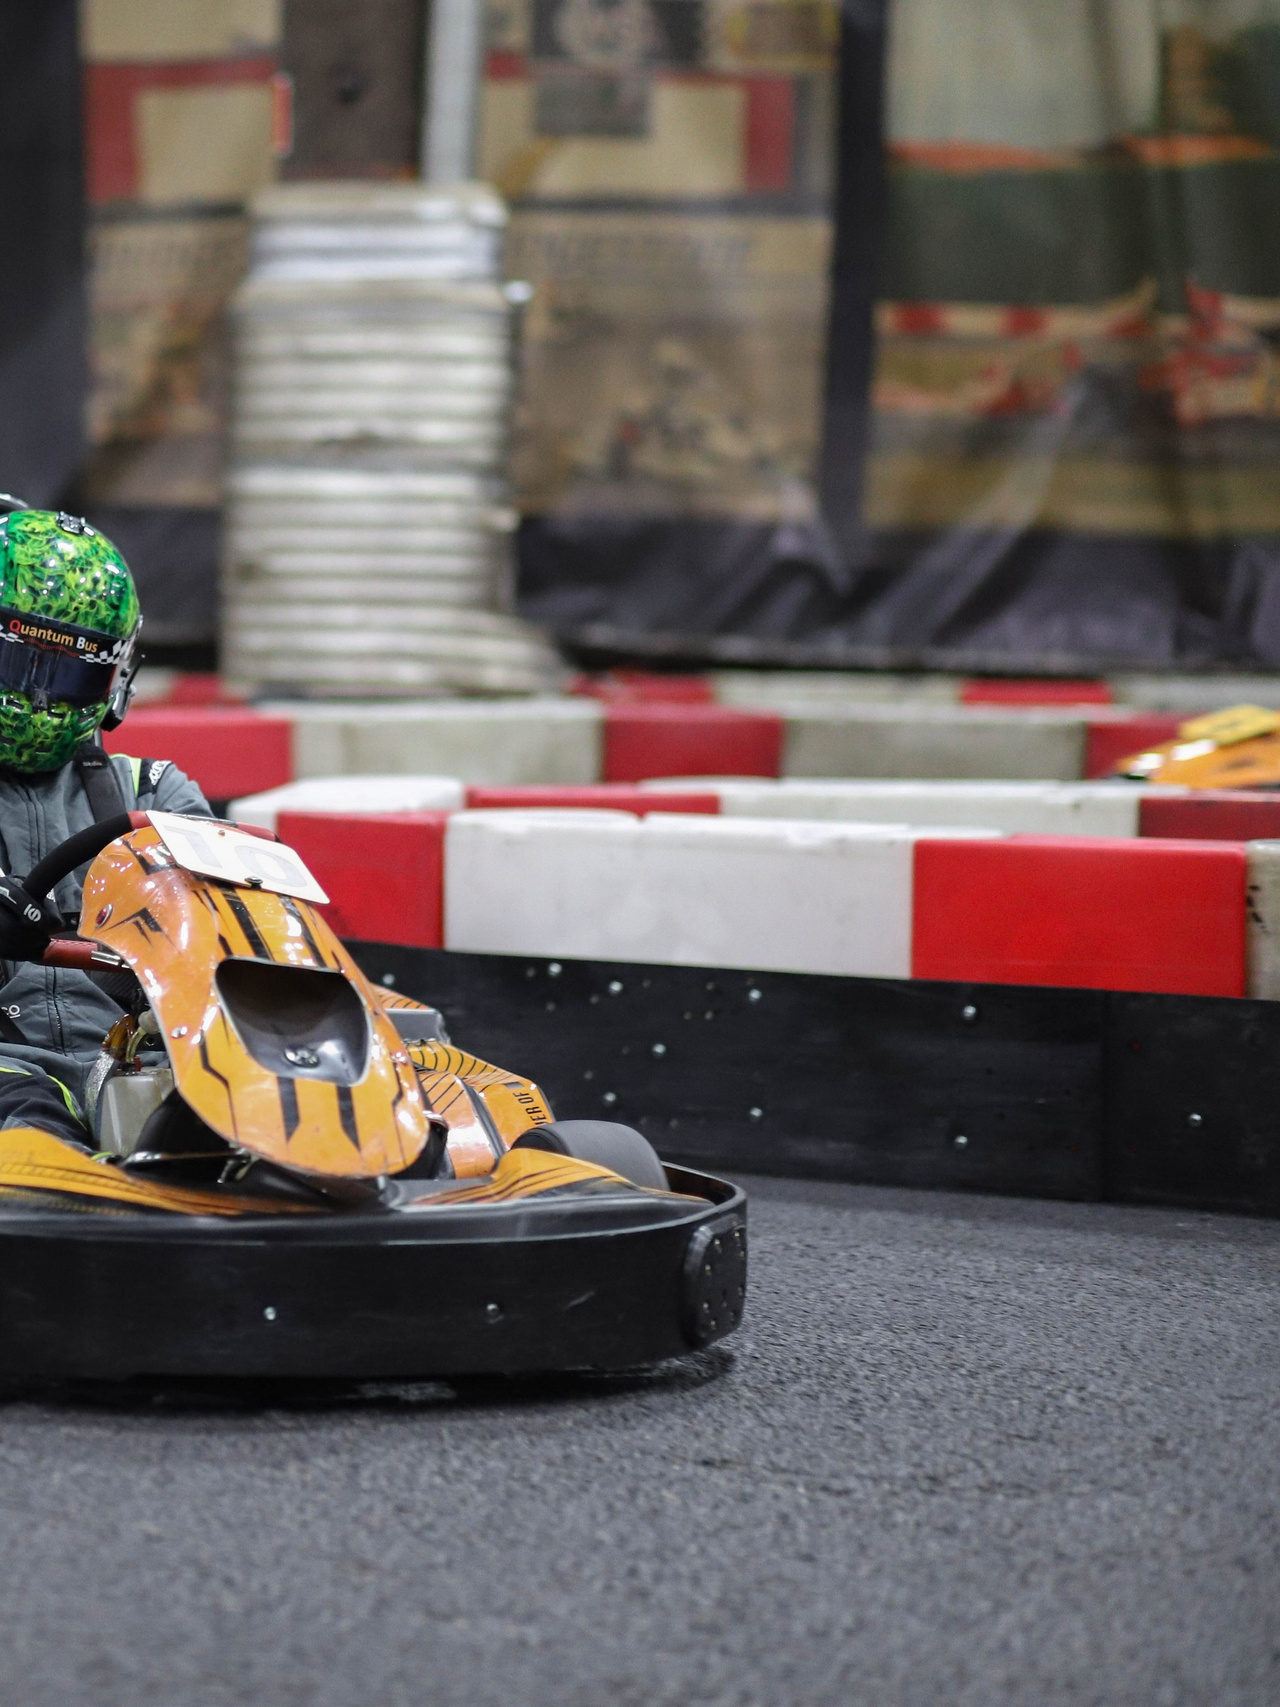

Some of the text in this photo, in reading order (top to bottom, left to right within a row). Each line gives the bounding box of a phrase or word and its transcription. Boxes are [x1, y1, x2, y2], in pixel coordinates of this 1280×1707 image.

[9, 619, 98, 653] Quantum Bus
[163, 824, 308, 888] 10
